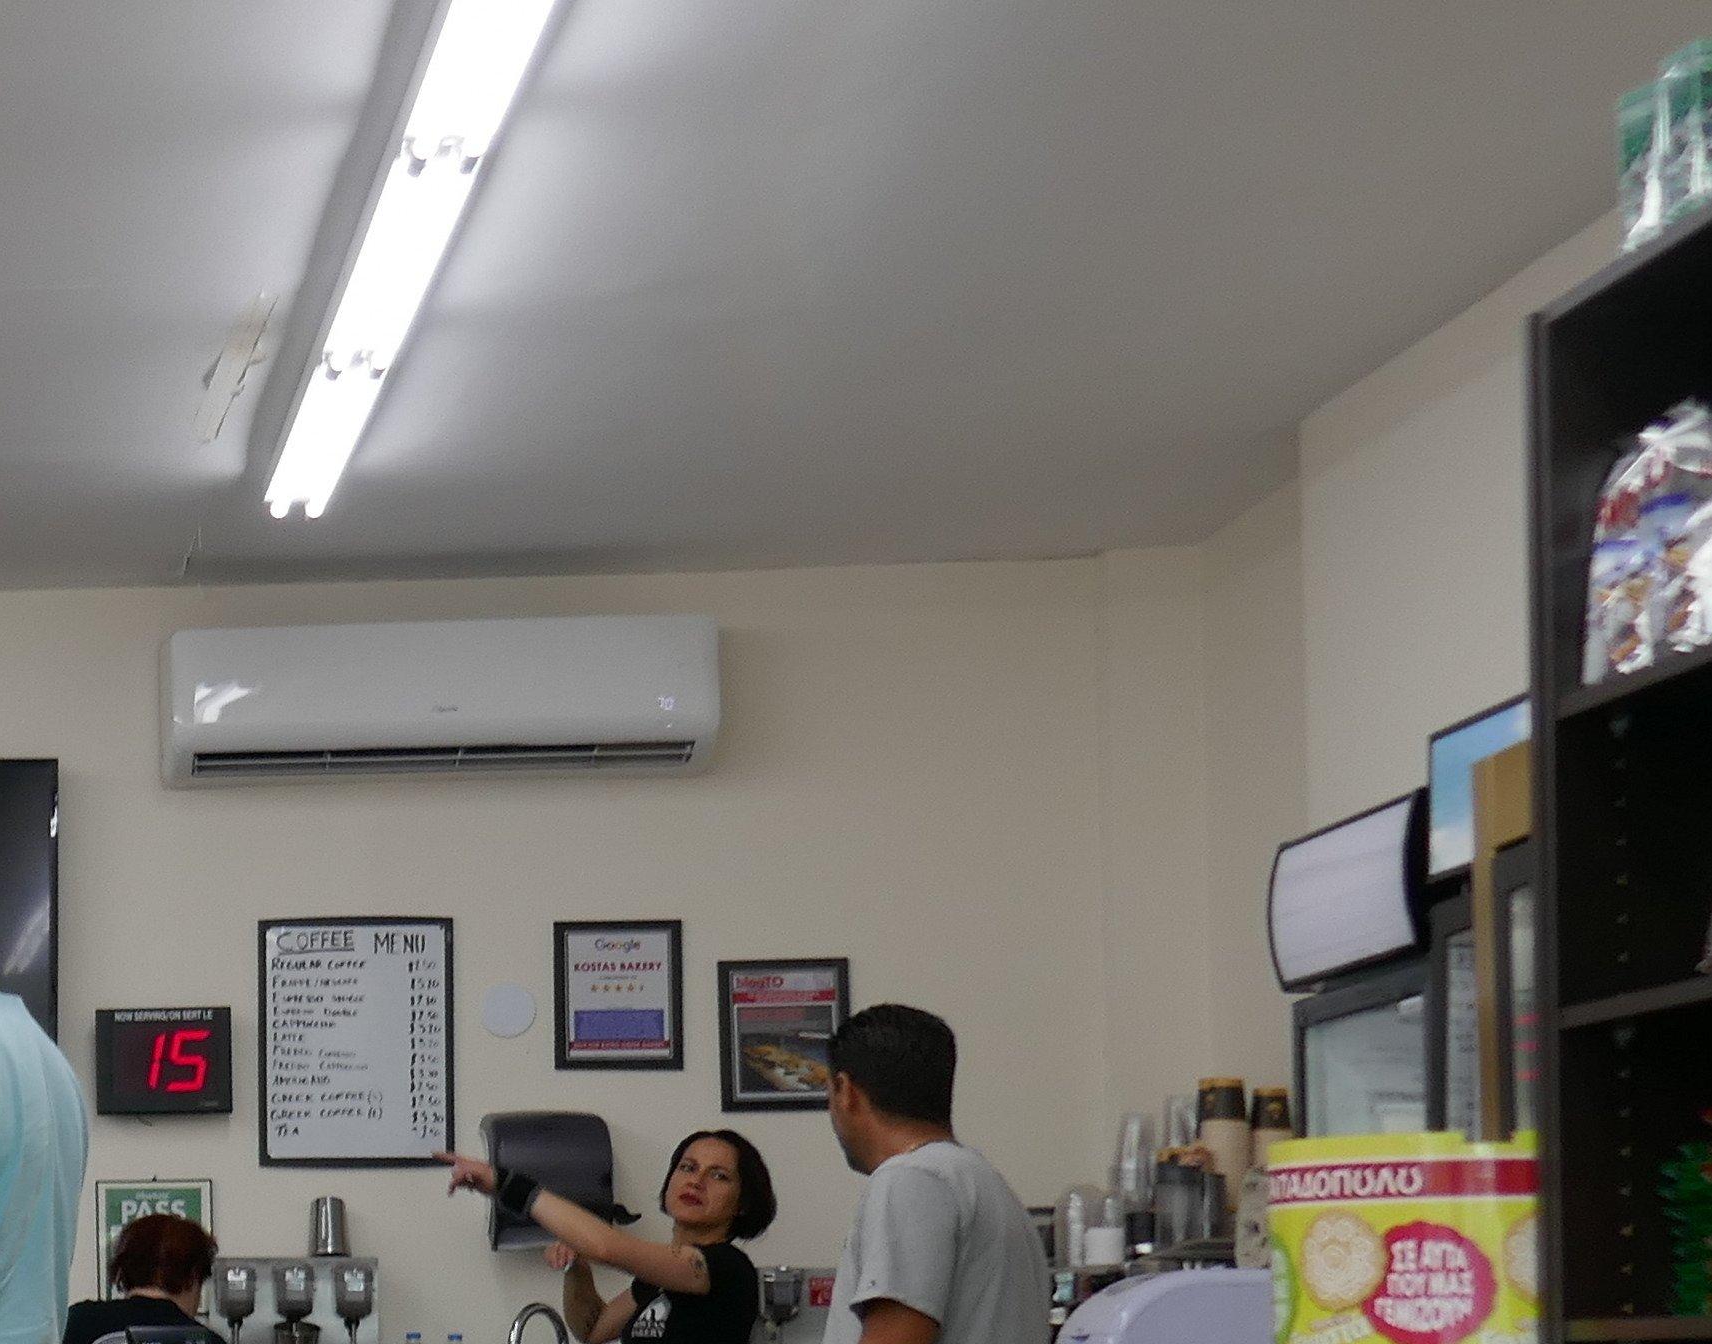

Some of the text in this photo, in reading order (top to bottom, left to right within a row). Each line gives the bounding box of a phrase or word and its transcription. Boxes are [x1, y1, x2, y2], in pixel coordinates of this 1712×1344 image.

[276, 929, 426, 954] COFFEE MENU
[595, 938, 641, 953] Google
[574, 961, 662, 972] KOSTAS BAKERY
[148, 1030, 212, 1093] 15
[121, 1199, 186, 1221] PASS
